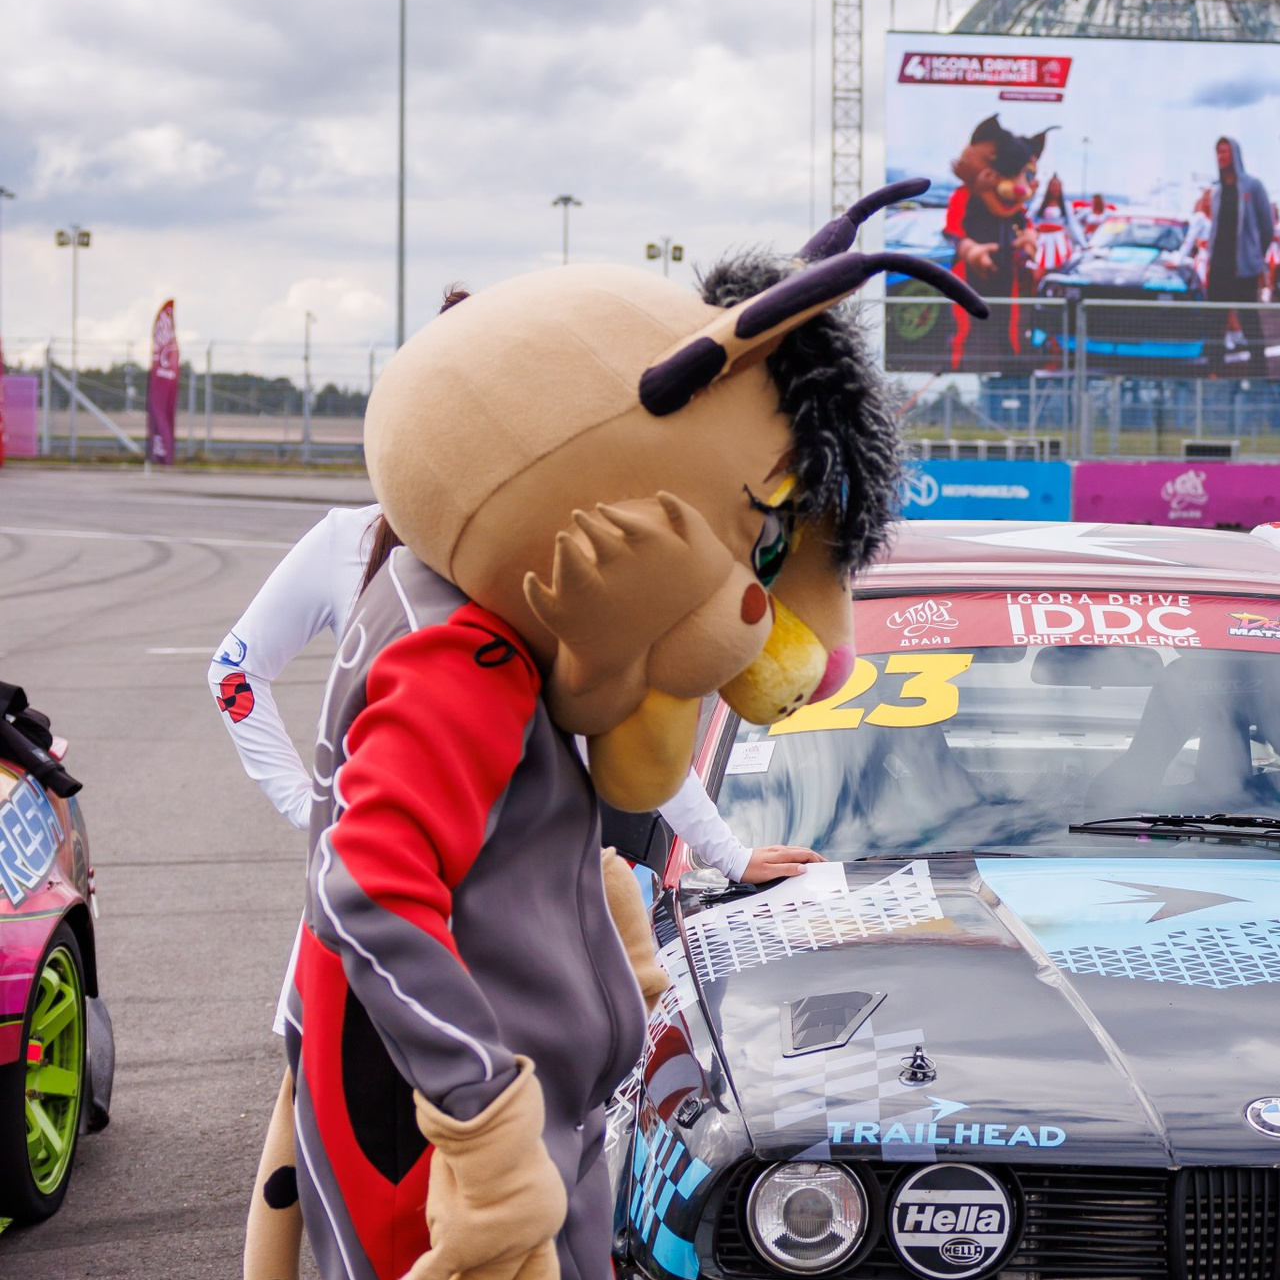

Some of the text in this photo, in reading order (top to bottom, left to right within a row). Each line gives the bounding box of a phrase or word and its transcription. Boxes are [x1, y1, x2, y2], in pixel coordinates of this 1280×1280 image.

[1006, 593, 1191, 607] IGORA DRIVE
[1007, 604, 1197, 636] IDDC
[900, 635, 951, 646] ДРАЙВ
[1013, 634, 1202, 646] DRIFT CHALLENGE
[827, 1121, 1067, 1147] TRAILHEAD
[903, 1205, 1001, 1232] Hella
[944, 1245, 983, 1256] HELLA
